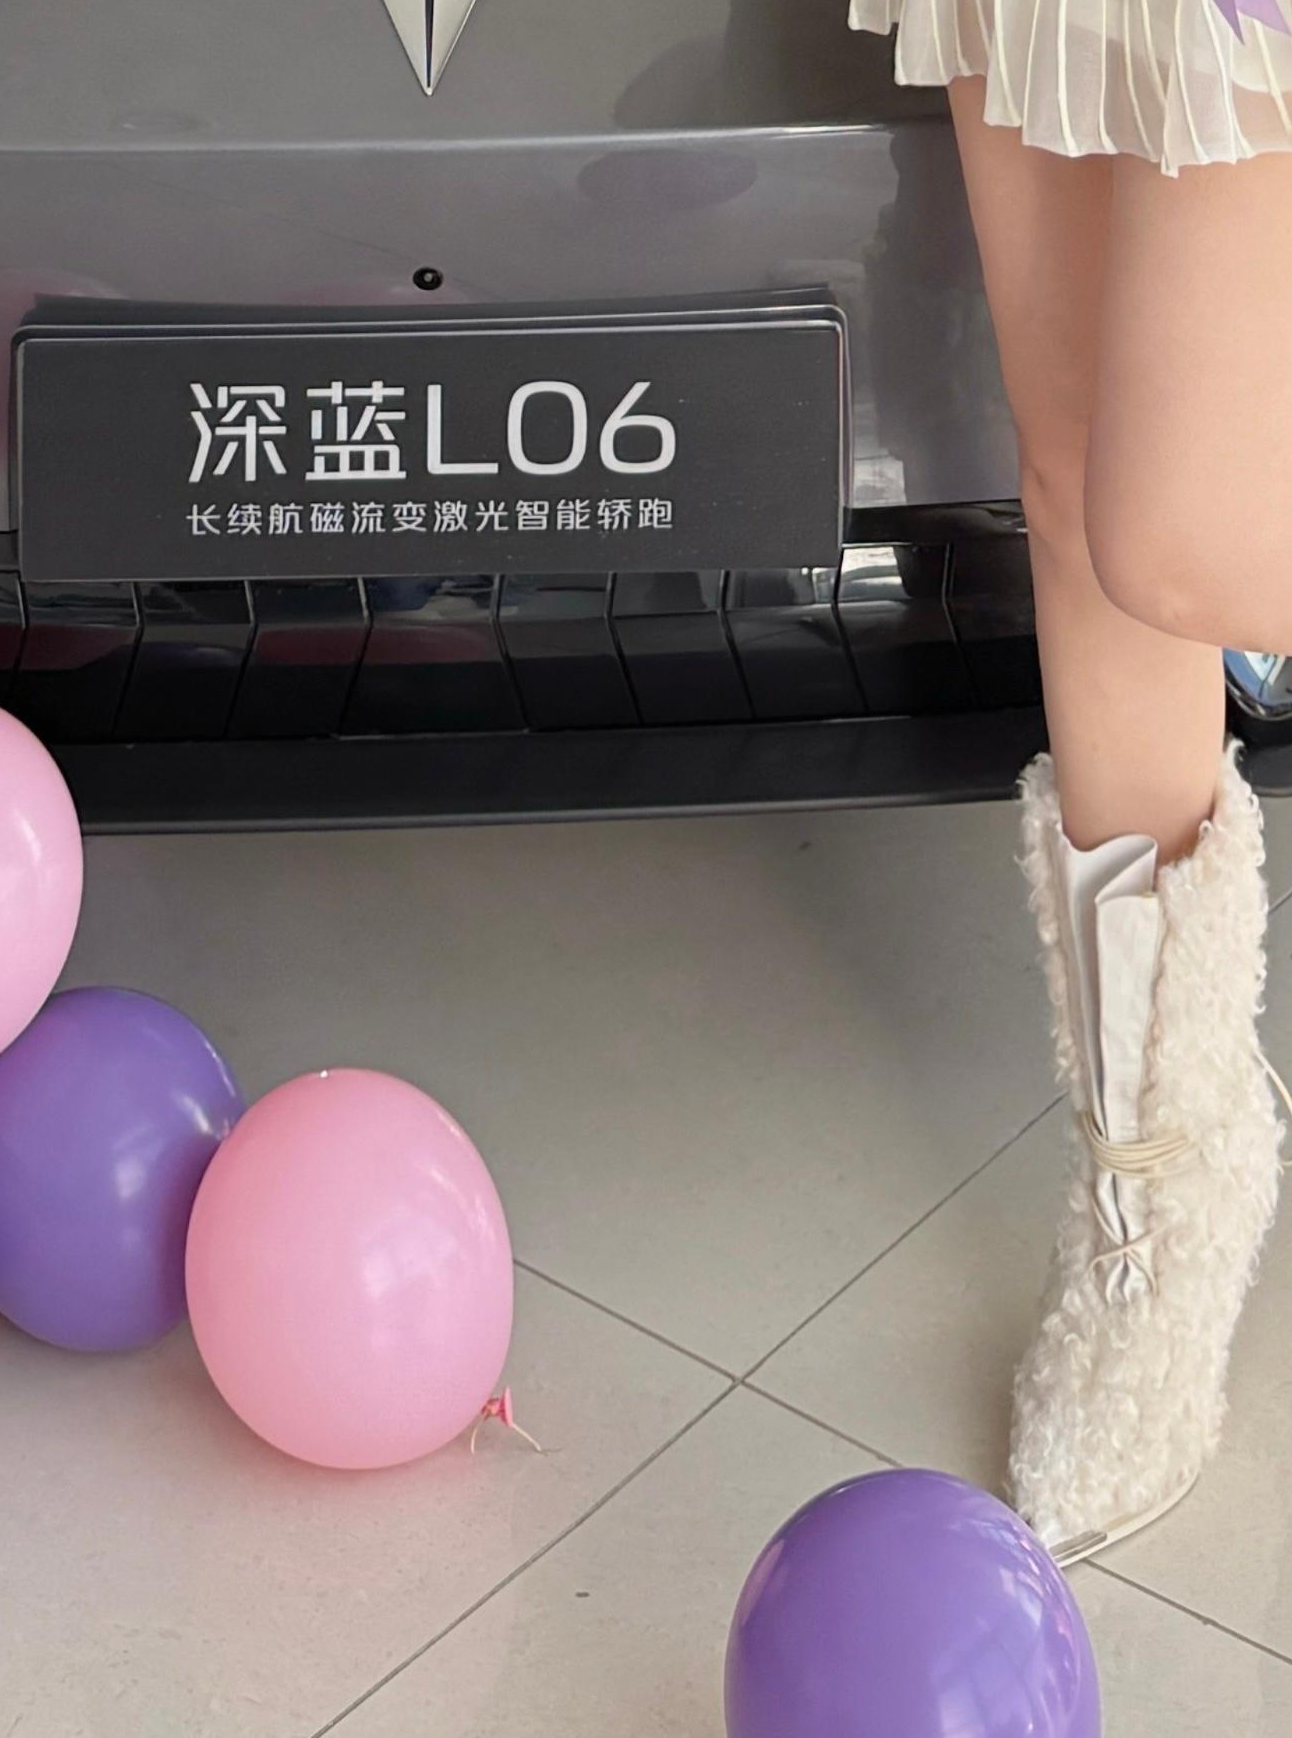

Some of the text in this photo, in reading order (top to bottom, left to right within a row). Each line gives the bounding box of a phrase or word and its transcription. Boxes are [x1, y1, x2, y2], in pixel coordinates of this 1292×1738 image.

[188, 380, 676, 483] 深蓝L06
[186, 498, 674, 536] 长续航磁流变激光智能轿跑
